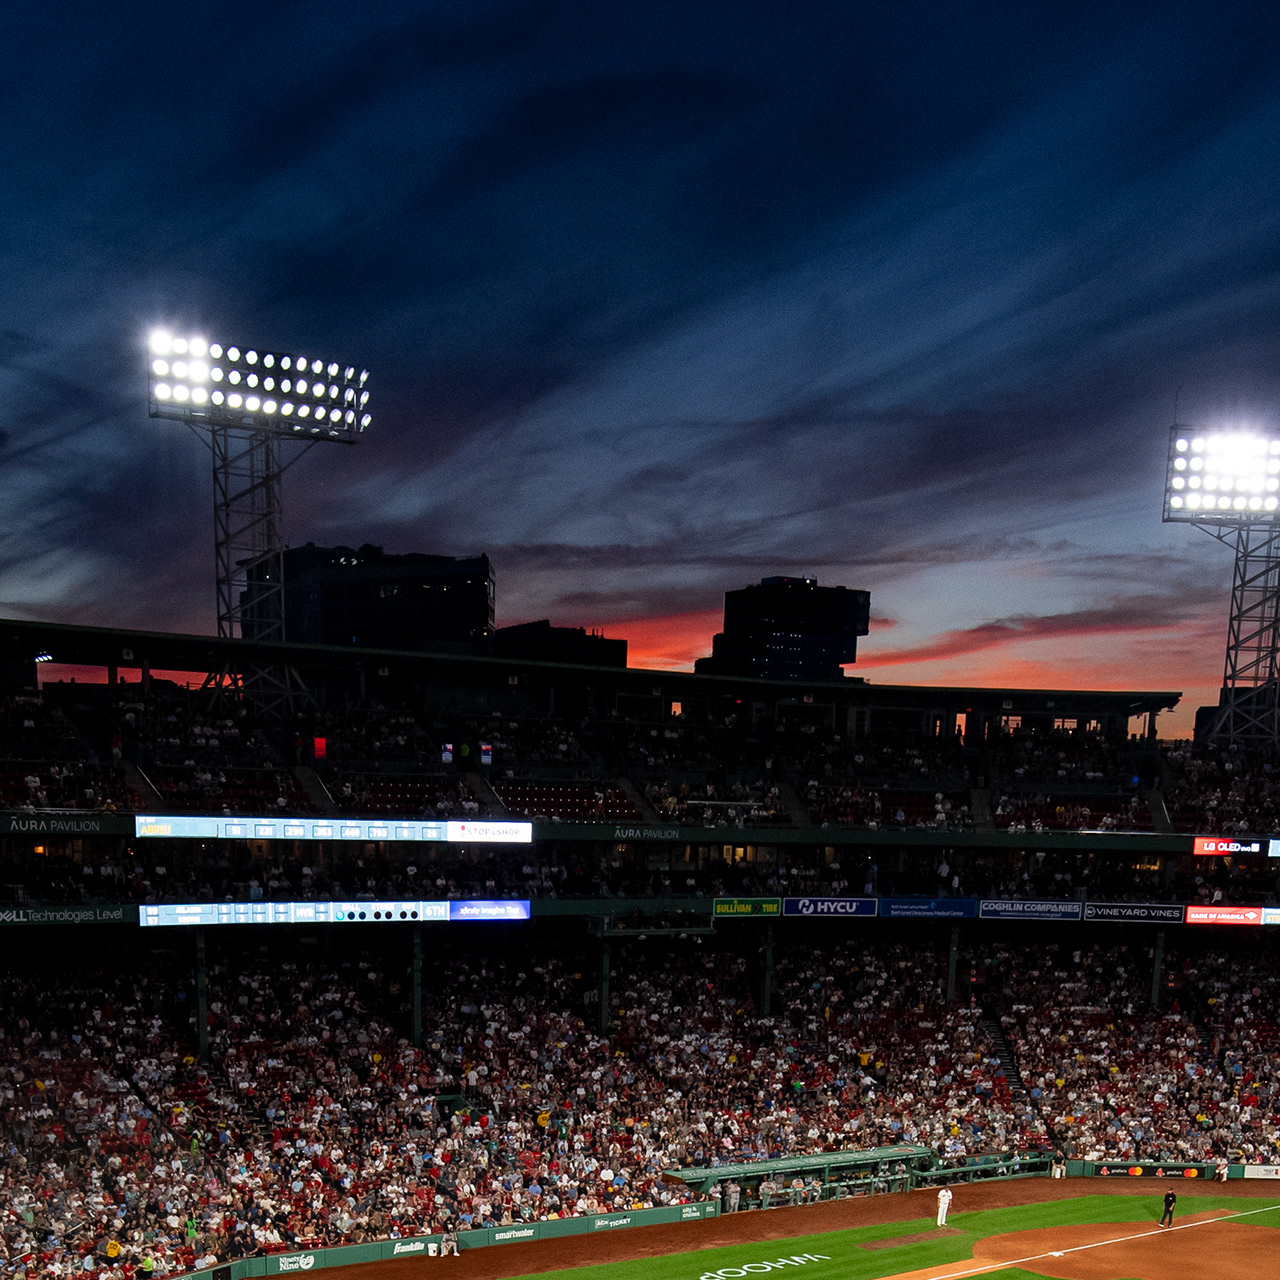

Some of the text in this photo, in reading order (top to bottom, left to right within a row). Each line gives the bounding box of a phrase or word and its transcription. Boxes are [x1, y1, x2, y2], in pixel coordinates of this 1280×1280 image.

[50, 821, 100, 832] PAVILION
[644, 828, 680, 840] PAVILION
[1203, 843, 1240, 852] LG OLED
[425, 905, 445, 917] 6TH
[716, 902, 778, 914] SULLIVAN TIRE
[816, 900, 856, 913] HYCU
[981, 902, 1080, 913] COGHLIN COMPANIES
[1096, 907, 1180, 918] VINEYARD VINES
[26, 909, 94, 924] Technologies
[96, 907, 123, 921] Level
[608, 1218, 631, 1228] TICKET
[494, 1228, 535, 1241] smartwater
[393, 1241, 425, 1255] Franklin
